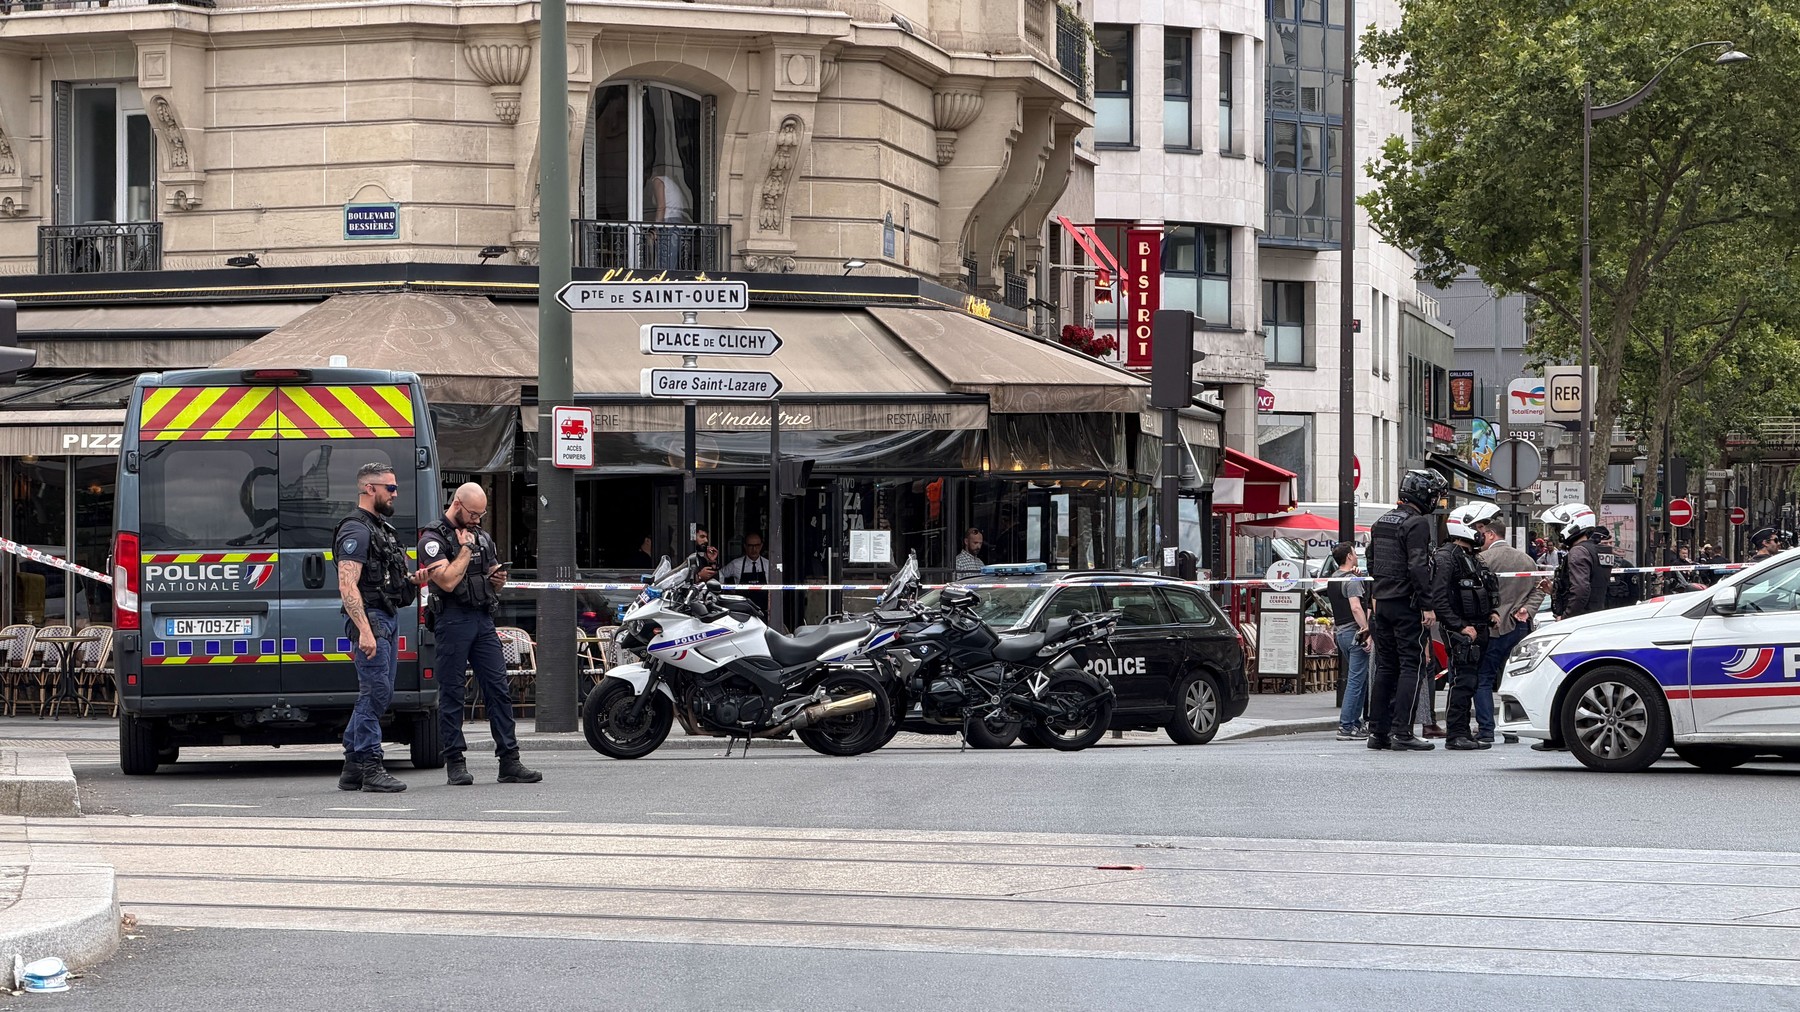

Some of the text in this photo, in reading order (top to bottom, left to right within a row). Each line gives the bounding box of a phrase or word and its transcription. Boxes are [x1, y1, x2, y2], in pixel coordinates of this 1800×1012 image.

[348, 211, 395, 220] BOULEVARD
[349, 219, 394, 230] BESSIÈRES
[611, 295, 625, 304] DE
[632, 289, 739, 303] SAINT-OUEN
[1136, 241, 1151, 356] BISTROT
[657, 332, 767, 350] PLACE DE CLICHY
[659, 376, 767, 392] Gare Saint-Lazare
[1555, 386, 1580, 401] RER
[1258, 396, 1274, 407] NCF
[706, 410, 812, 426] l'Indutrie
[887, 413, 951, 425] RESTAURANT
[63, 434, 122, 448] PIZZ
[563, 453, 586, 461] POMPIERS
[1308, 538, 1338, 547] OLIC
[145, 564, 240, 581] POLICE
[145, 582, 240, 592] NATIONALE
[177, 620, 241, 633] GN-709-ZF
[674, 632, 707, 645] POLICE
[1083, 656, 1146, 675] POLICE
